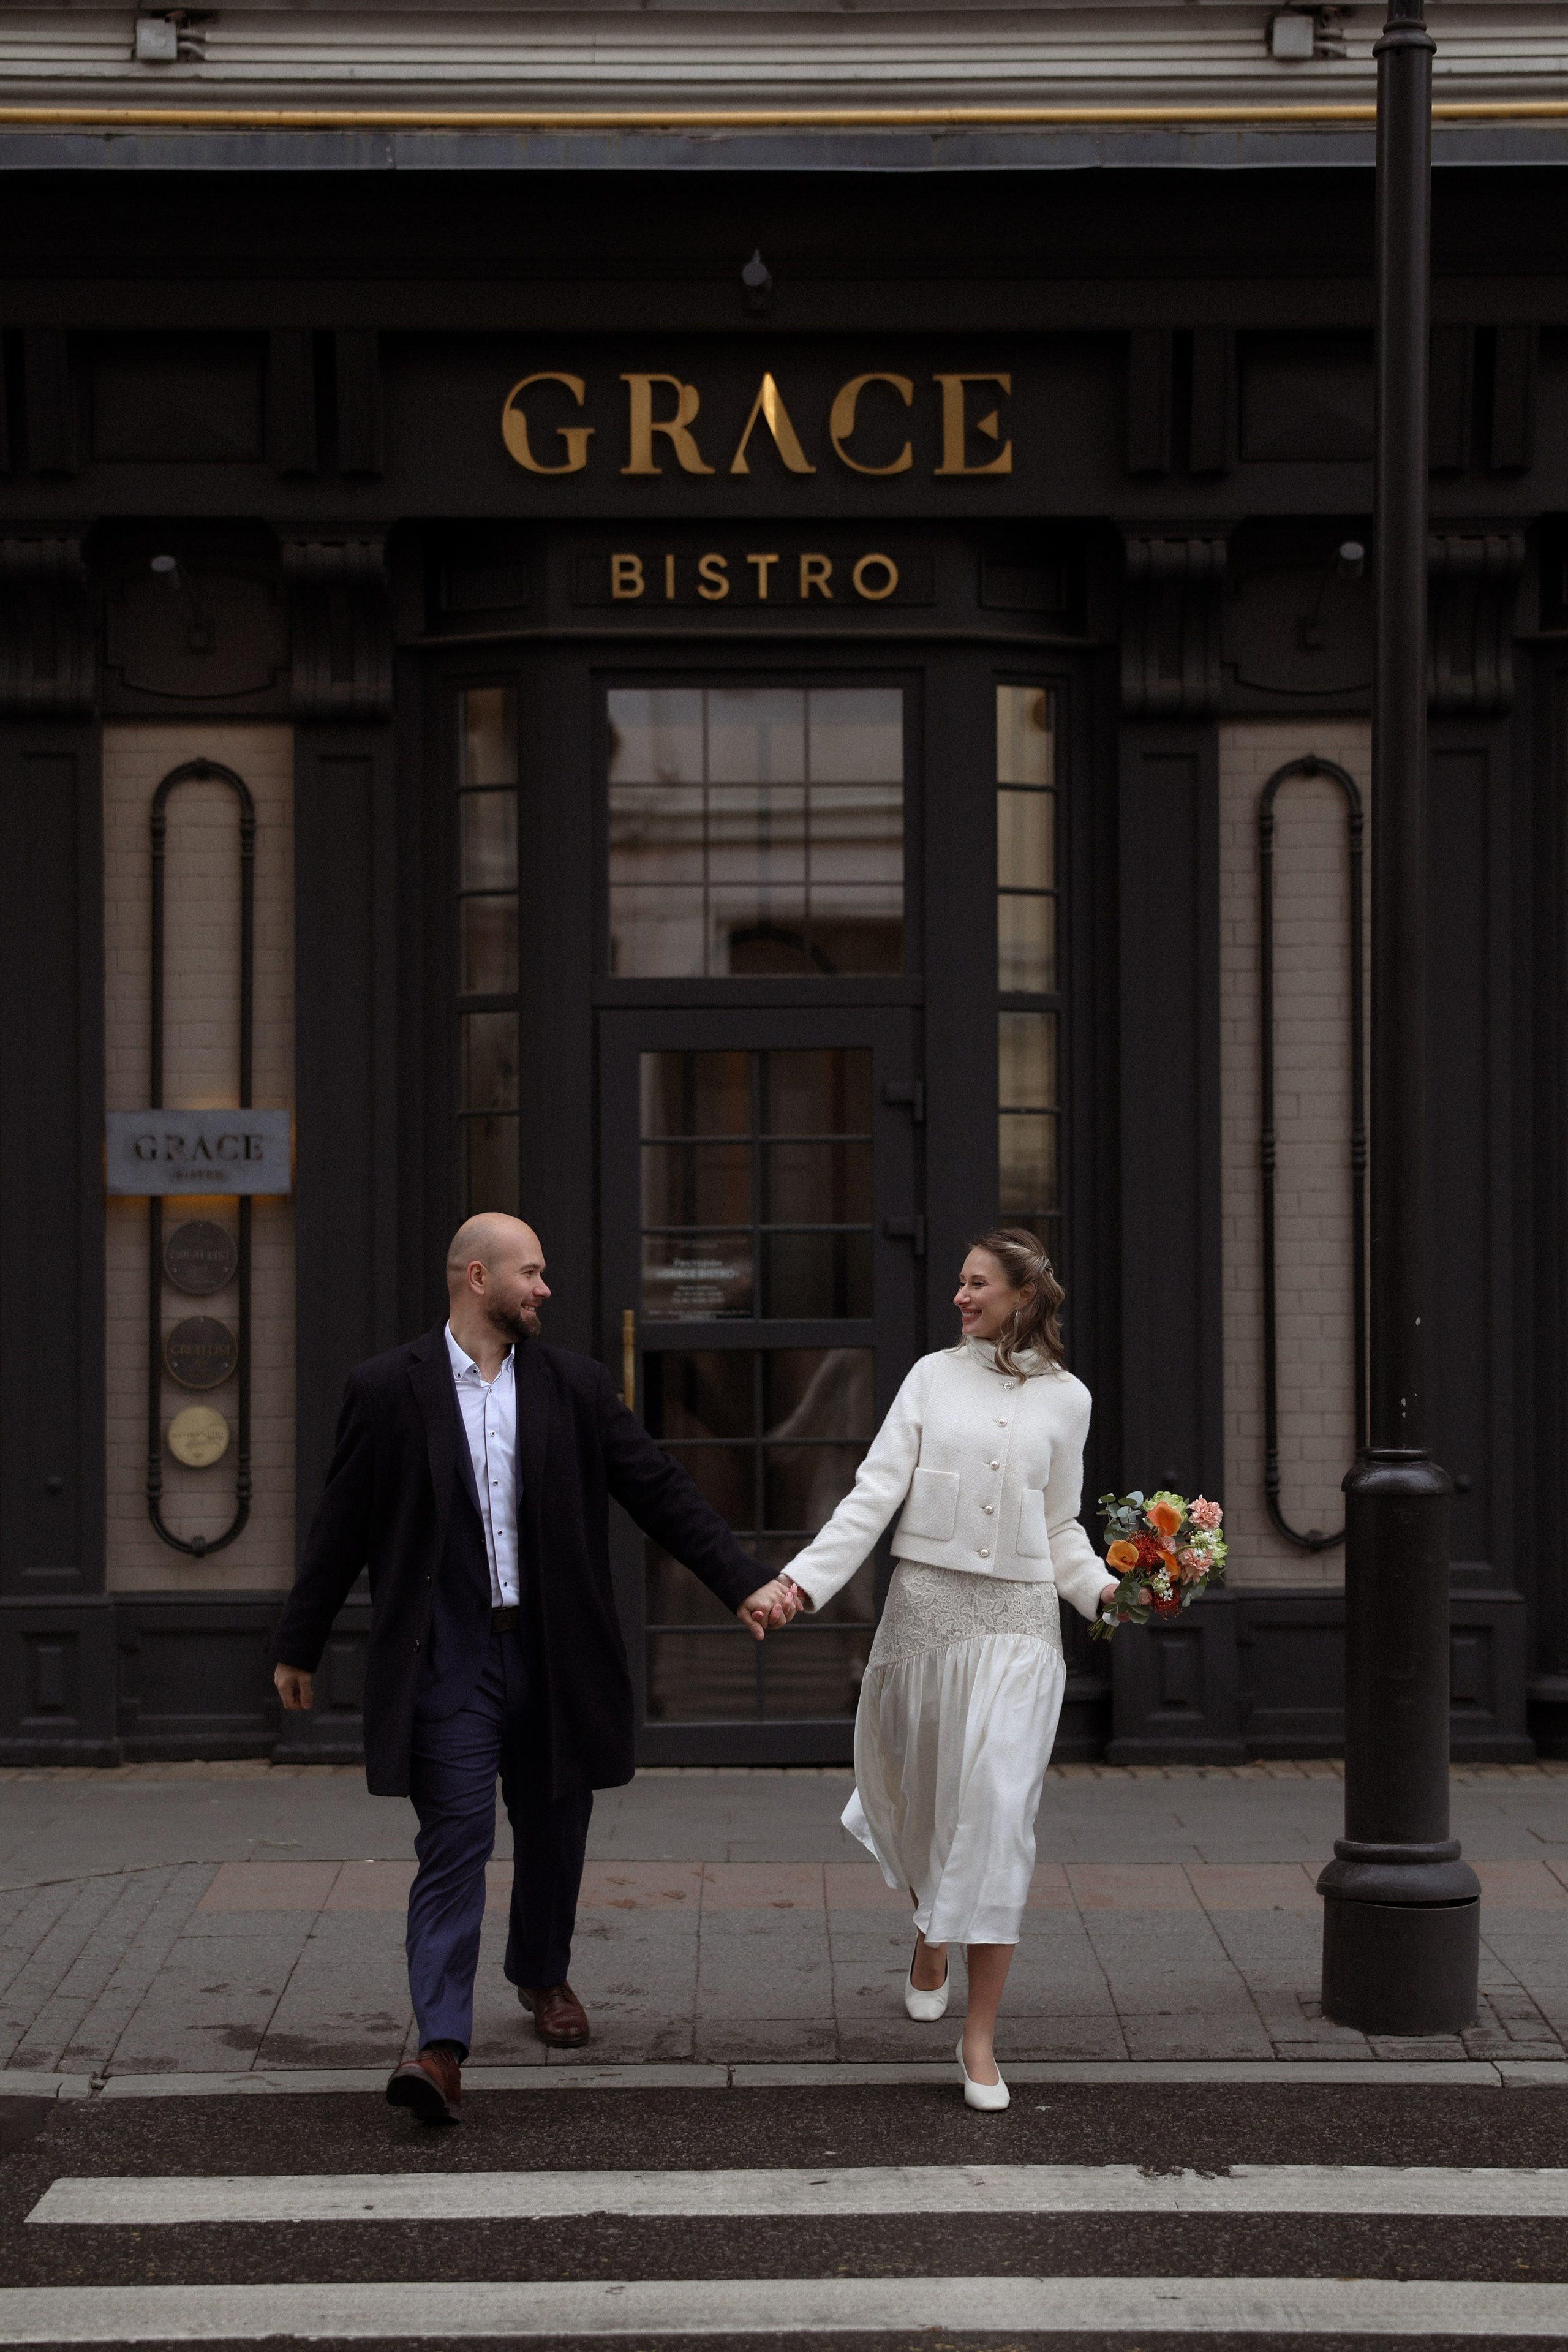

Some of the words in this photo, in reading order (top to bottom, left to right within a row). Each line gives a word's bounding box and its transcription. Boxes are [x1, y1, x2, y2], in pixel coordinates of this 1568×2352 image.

[502, 372, 1012, 475] GRACE
[612, 553, 899, 600] BISTRO
[134, 1134, 264, 1162] GRACE
